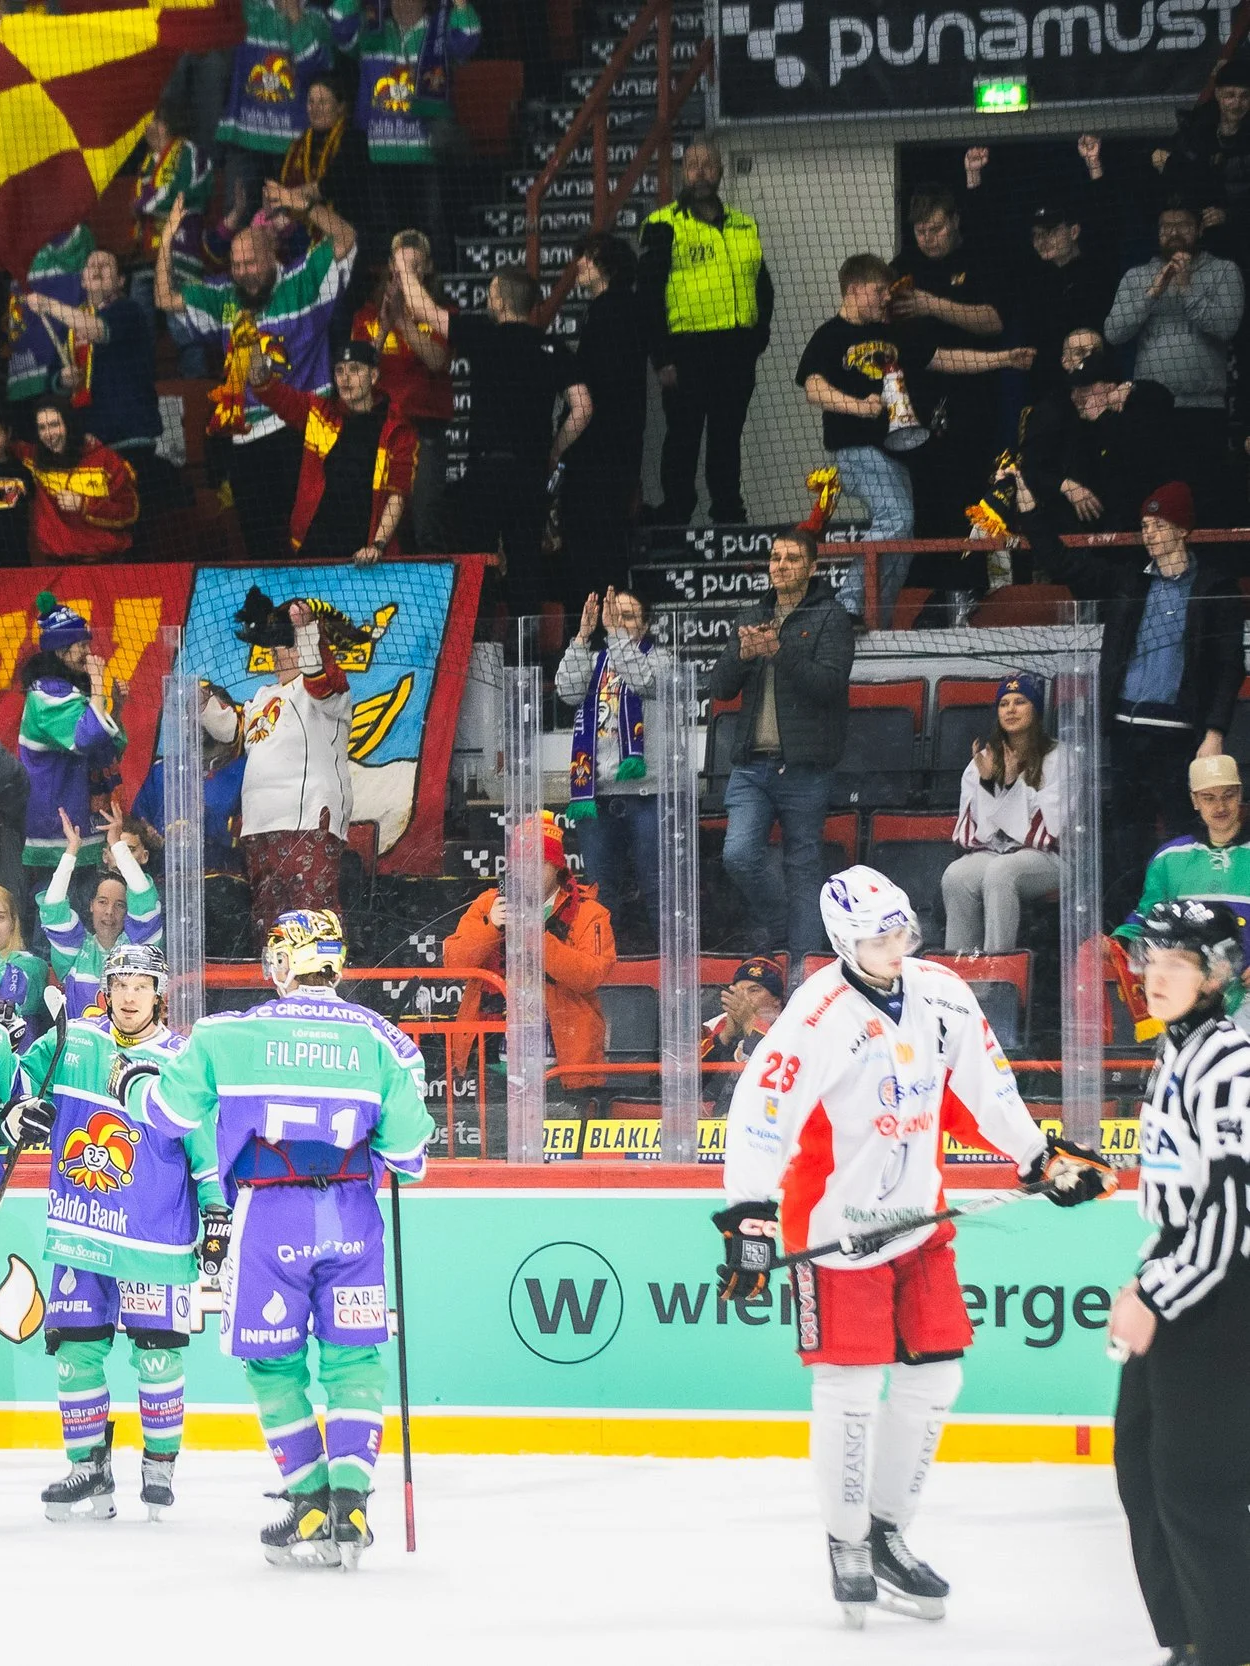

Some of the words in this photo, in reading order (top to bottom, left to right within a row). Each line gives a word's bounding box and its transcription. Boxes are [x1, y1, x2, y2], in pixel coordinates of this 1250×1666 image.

[829, 0, 1250, 87] punamust
[276, 1003, 374, 1026] CIRCULATION
[291, 1027, 339, 1040] LÖFBERGS
[265, 1040, 360, 1072] FILPPULA
[757, 1050, 800, 1093] 28
[590, 1121, 661, 1149] BLÅKLÄ
[48, 1188, 87, 1223] Saldo
[90, 1198, 128, 1234] Bank
[46, 1300, 92, 1314] NFUEL
[121, 1297, 162, 1312] CREW
[337, 1289, 384, 1306] CABLE
[524, 1278, 607, 1335] W
[338, 1308, 381, 1325] CREW
[239, 1326, 300, 1345] INFUEL
[143, 1355, 167, 1373] W
